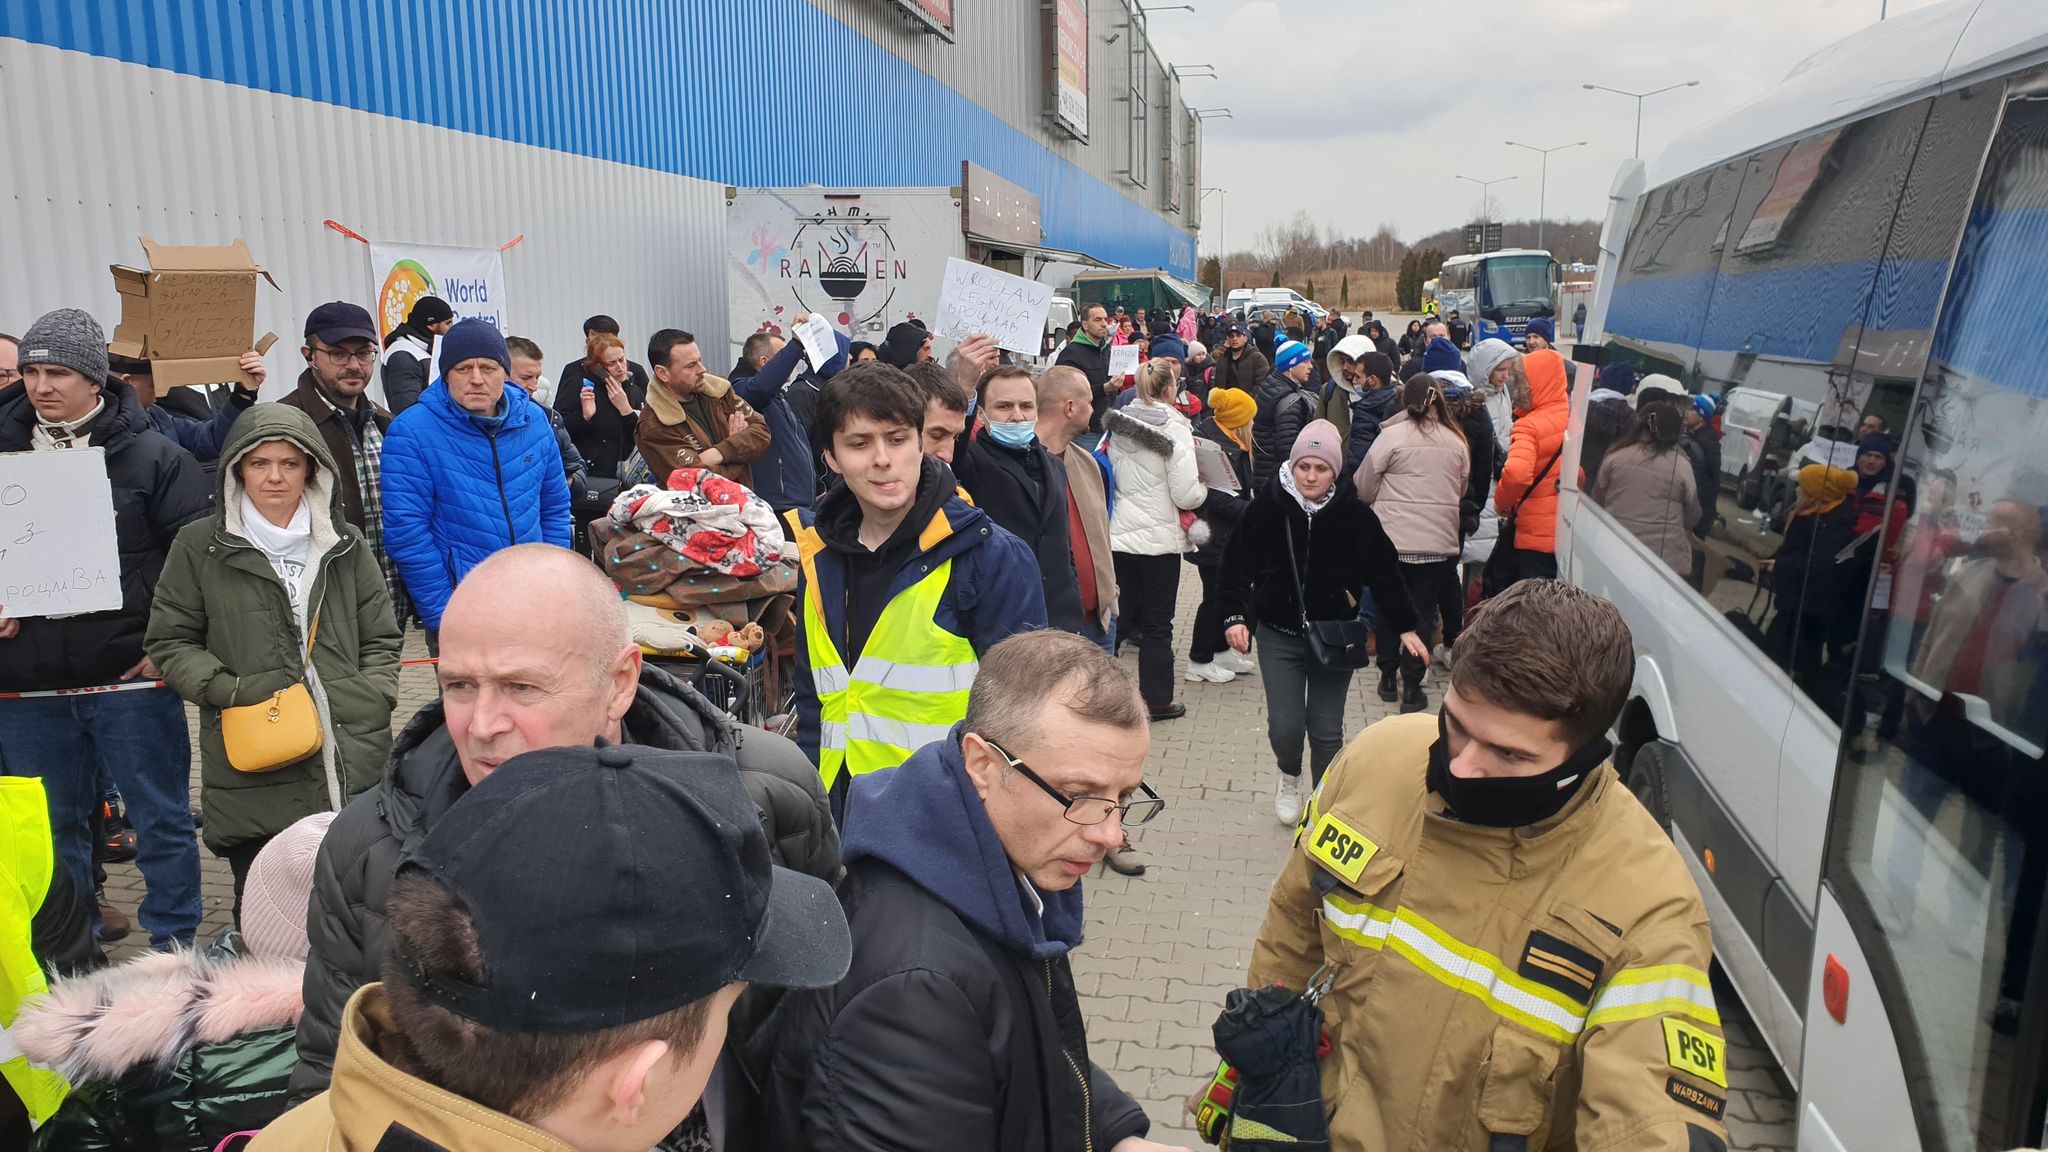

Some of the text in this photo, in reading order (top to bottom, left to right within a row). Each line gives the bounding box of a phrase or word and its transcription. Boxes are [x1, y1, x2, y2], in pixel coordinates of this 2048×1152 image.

[445, 278, 488, 303] World
[958, 289, 1031, 324] LEGNICA
[1315, 823, 1364, 866] PSP
[1677, 1029, 1717, 1073] PSP
[1673, 1082, 1719, 1113] WARSZAWA
